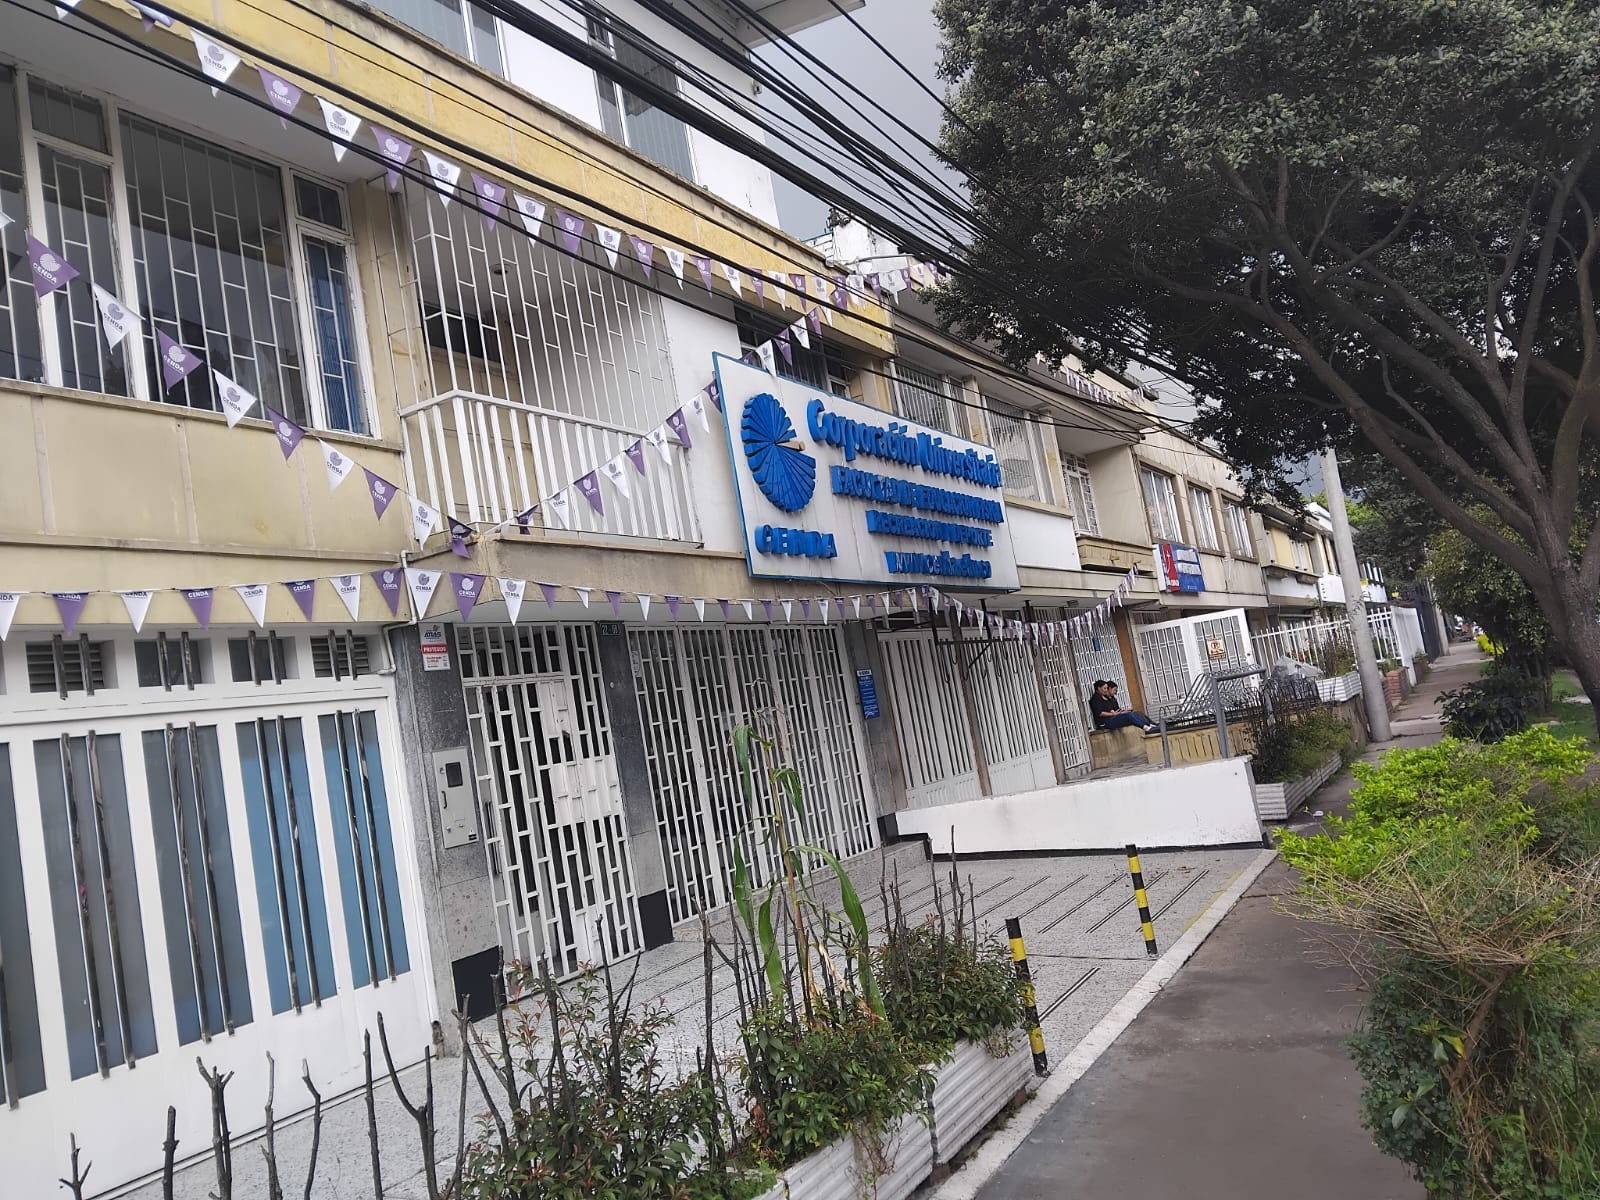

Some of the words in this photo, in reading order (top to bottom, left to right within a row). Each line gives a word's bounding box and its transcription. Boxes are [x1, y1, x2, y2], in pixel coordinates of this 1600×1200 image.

[203, 55, 228, 72] CENDA
[270, 90, 292, 105] CENDA
[32, 262, 57, 283] CENDA
[103, 312, 124, 331] CENDA
[163, 354, 185, 373] CENDA
[754, 524, 837, 559] CENDA
[188, 590, 209, 598] CENDA
